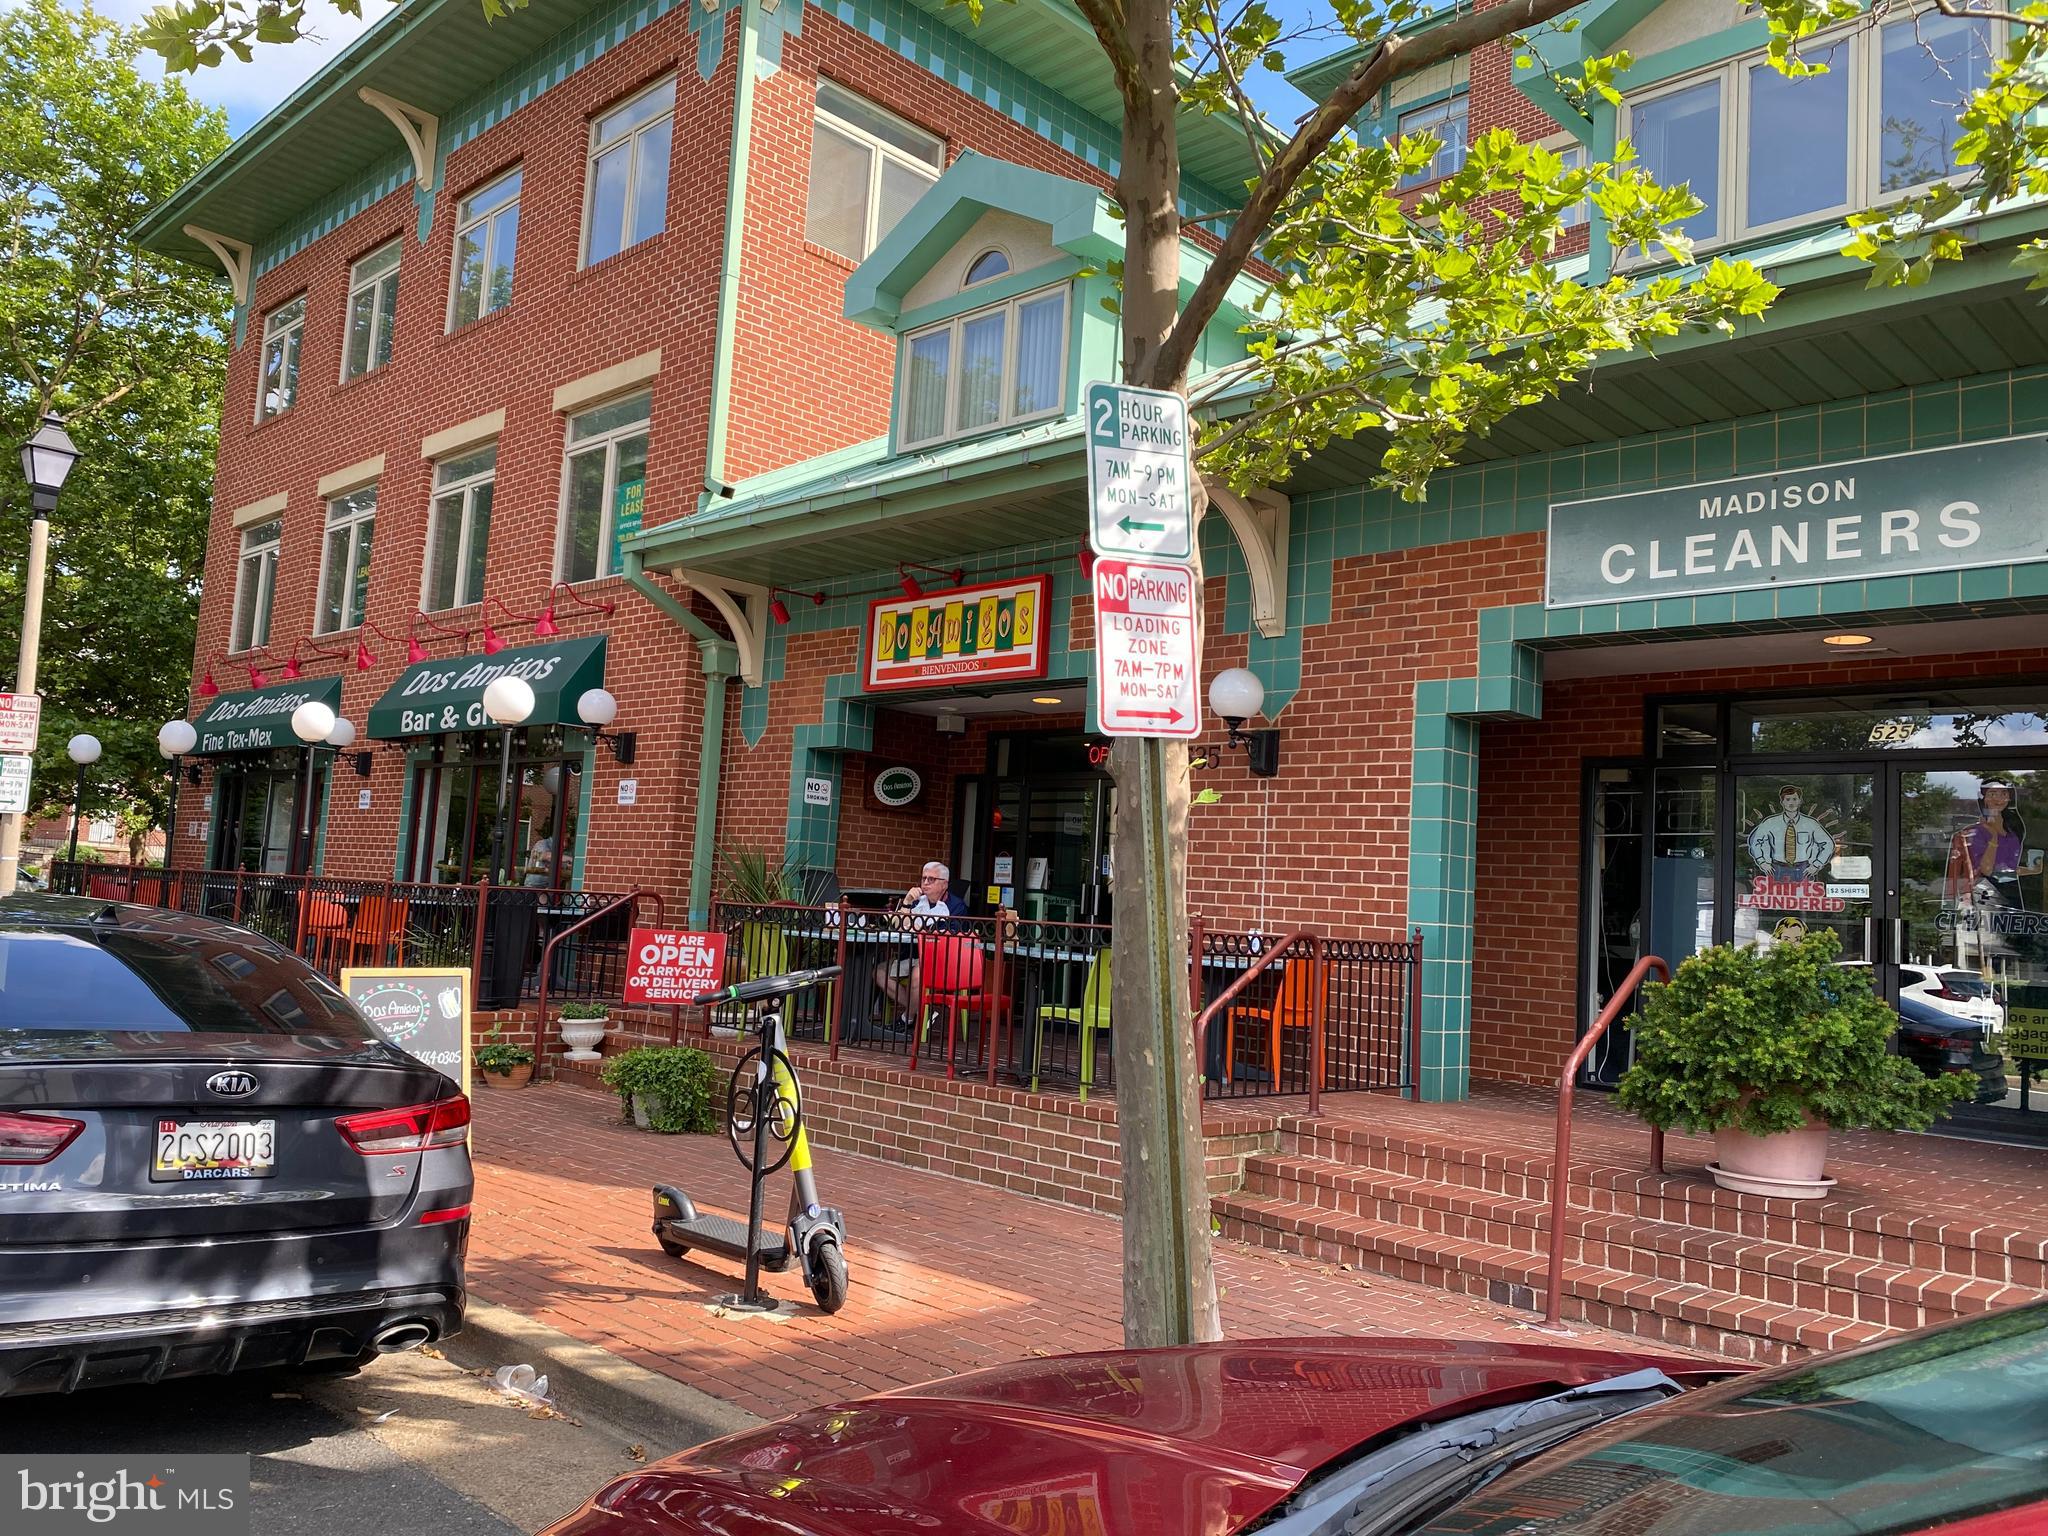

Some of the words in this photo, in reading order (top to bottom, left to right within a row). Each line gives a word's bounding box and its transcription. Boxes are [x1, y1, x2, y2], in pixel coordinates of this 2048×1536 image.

[1094, 398, 1114, 438] 2
[1121, 400, 1163, 423] HOUR
[1121, 423, 1182, 447] PARKING
[626, 484, 642, 499] FOR
[1107, 487, 1175, 509] MON-SAT
[1699, 477, 1856, 520] MADISON
[1599, 500, 1983, 586] CLEANERS
[1099, 572, 1128, 601] NO
[1130, 578, 1187, 604] PARKING
[1114, 615, 1181, 635] LOADING
[1128, 638, 1169, 656] ZONE
[921, 661, 980, 676] BIENVENIDOS
[1114, 659, 1184, 681] 7AM-7PM
[401, 670, 456, 697] Dos
[1120, 682, 1179, 699] MON-SAT
[205, 701, 245, 722] Dos
[238, 692, 310, 718] Amigos
[401, 710, 435, 733] Bar
[440, 705, 459, 729] &
[202, 733, 224, 751] Fine
[226, 727, 272, 749] Tex-Mex
[1871, 725, 1912, 740] 525
[807, 782, 820, 792] NO
[806, 794, 829, 802] SMOKING
[1753, 875, 1825, 897] Shirts
[1738, 894, 1845, 912] LAUNDERED
[654, 933, 676, 945] WE
[678, 935, 705, 946] ARE
[640, 944, 715, 968] OPEN
[637, 965, 714, 978] CARRY-OUT
[629, 976, 649, 987] OR
[652, 977, 719, 990] DELIVERY
[363, 1004, 387, 1018] Dos
[388, 1000, 420, 1015] Amigos
[215, 1076, 251, 1092] KIA
[164, 1122, 174, 1131] 11
[160, 1132, 272, 1164] 2CS2003
[183, 1167, 251, 1179] DARCARS
